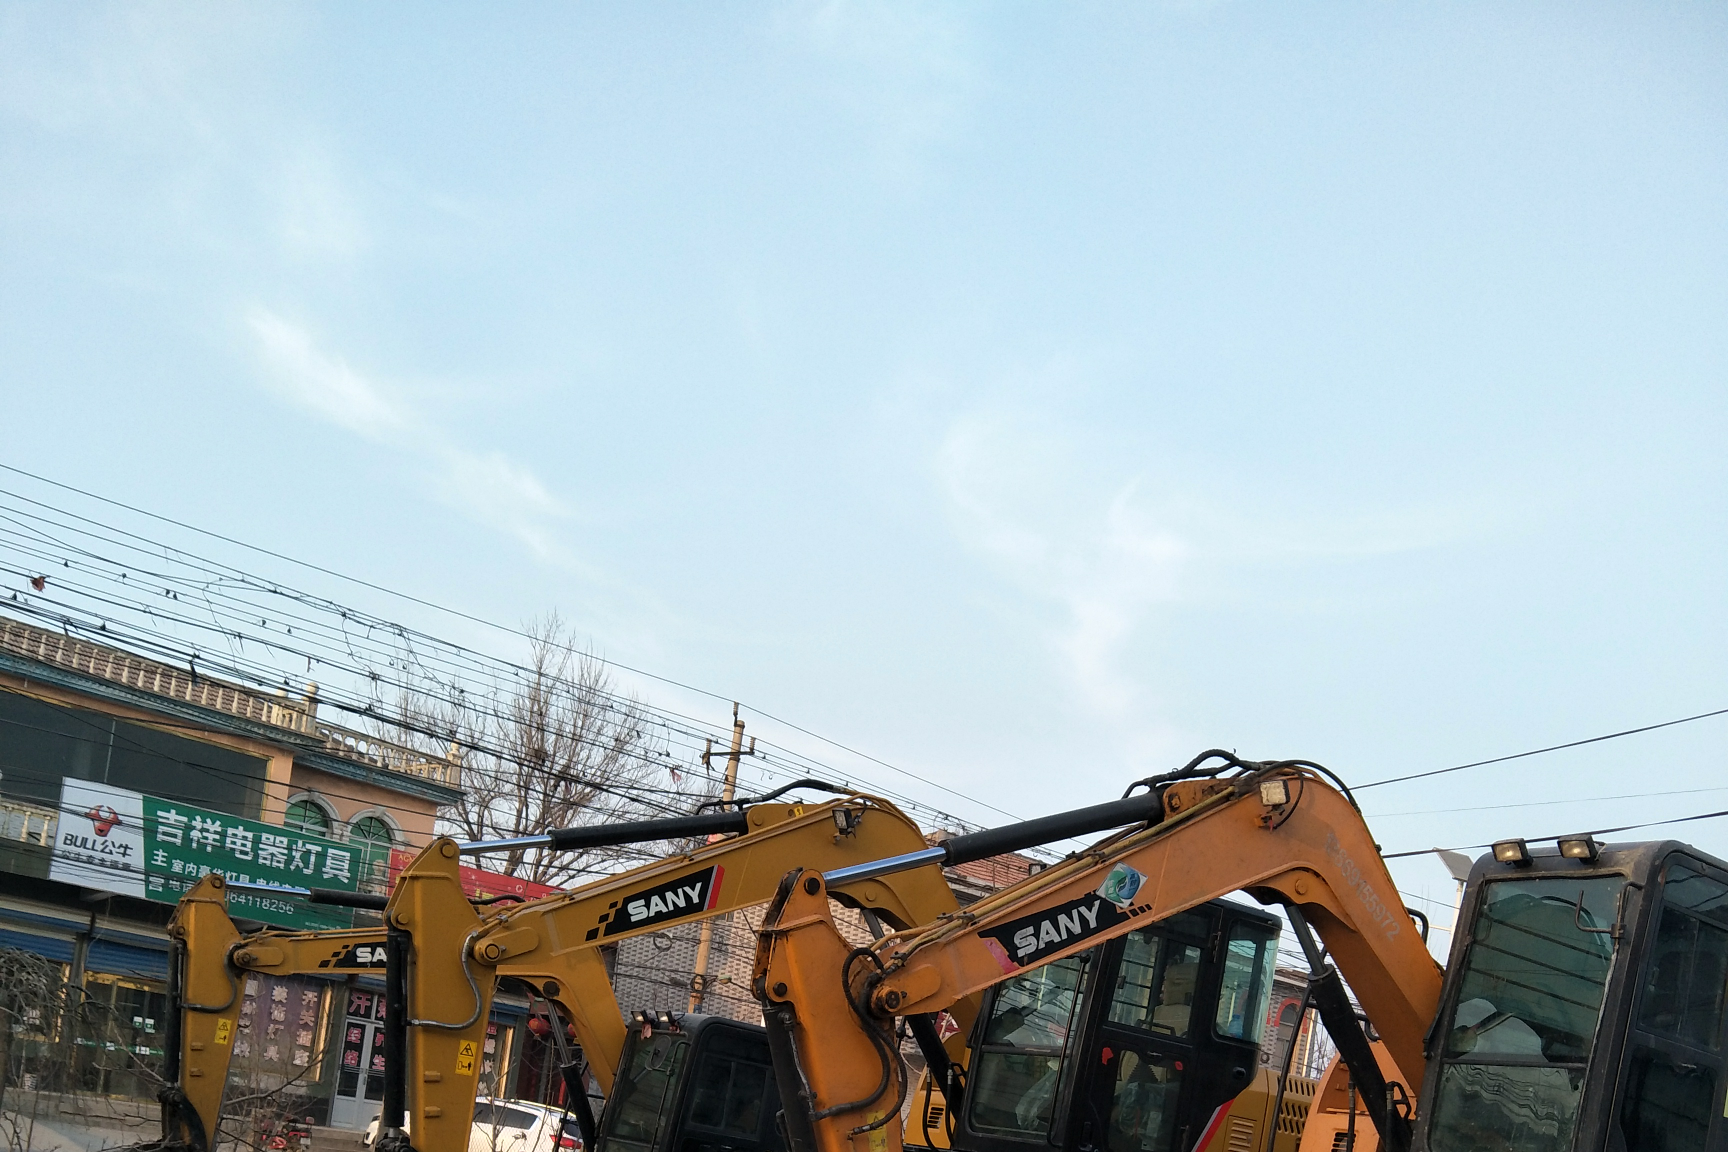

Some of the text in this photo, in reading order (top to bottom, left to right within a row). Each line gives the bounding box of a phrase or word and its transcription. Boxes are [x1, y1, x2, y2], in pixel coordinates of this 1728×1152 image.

[156, 809, 351, 883] 吉祥电器灯具
[226, 890, 294, 915] 64118256
[627, 881, 702, 922] SANY
[1013, 899, 1101, 958] SANY
[355, 946, 387, 963] SA
